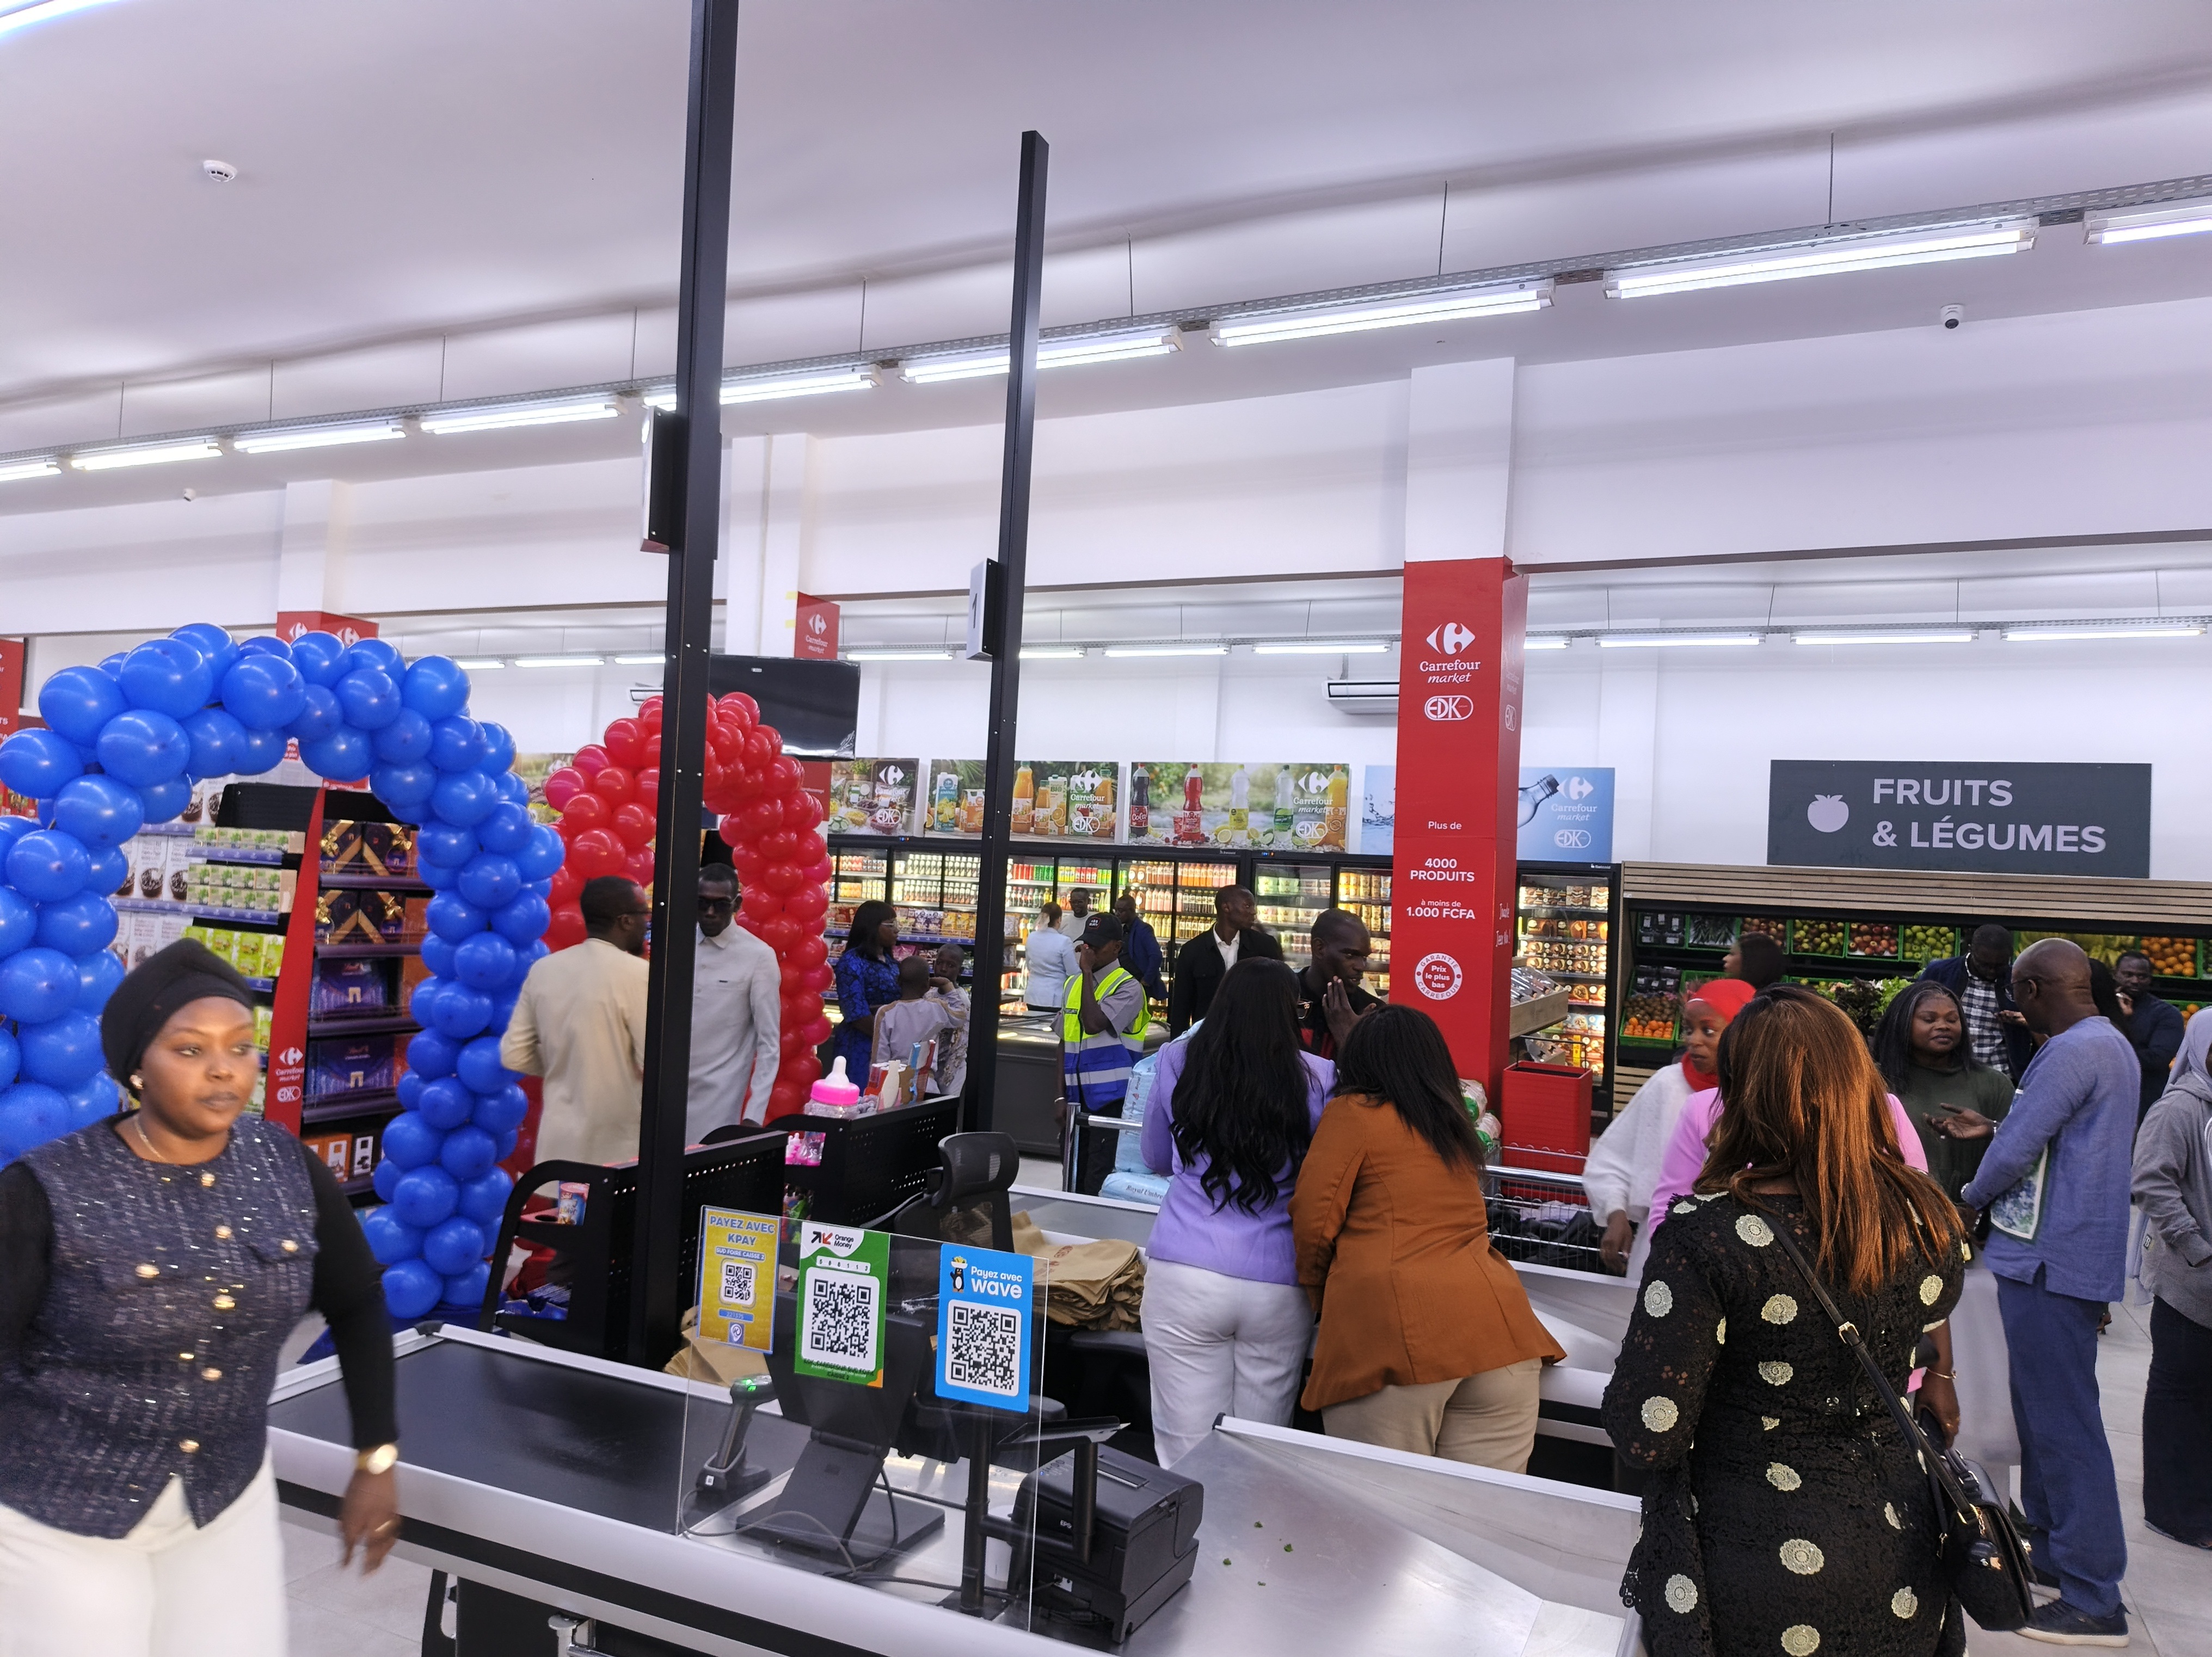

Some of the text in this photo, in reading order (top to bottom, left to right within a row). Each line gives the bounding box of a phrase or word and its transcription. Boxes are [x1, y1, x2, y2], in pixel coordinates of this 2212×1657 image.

[972, 593, 978, 629] 1
[806, 635, 828, 648] Carrefour
[1420, 659, 1481, 672] Carrefour
[1428, 672, 1472, 683] market
[1426, 696, 1463, 719] EDK
[1070, 793, 1105, 802] Carrefour
[1873, 778, 2013, 806] FRUITS
[1293, 797, 1334, 805] Carrefour
[1551, 804, 1597, 812] Carrefour
[1132, 812, 1146, 821] Cola
[1557, 814, 1590, 822] market
[1073, 817, 1094, 832] EDK
[1297, 821, 1320, 839] EDK
[1428, 821, 1448, 830] Plus
[1555, 830, 1583, 848] EDK
[1872, 815, 2106, 853] & LÉGUMES
[1424, 858, 1457, 868] 4000
[1410, 870, 1475, 882] PRODUITS
[1406, 906, 1476, 919] 1.000 FCFA
[1420, 954, 1459, 969] GARANTIE
[1431, 965, 1447, 973] Prix
[1418, 982, 1460, 999] CARREFOUR
[1144, 1189, 1164, 1199] Umbre
[710, 1216, 775, 1234] PAYEZ AVEC
[728, 1234, 757, 1246] KPAY
[834, 1234, 854, 1243] Orange
[834, 1240, 852, 1249] Money
[742, 1251, 760, 1259] CAISSE
[971, 1266, 1022, 1282] Payez avec
[971, 1278, 1022, 1299] wave
[1060, 1520, 1072, 1529] EPS
